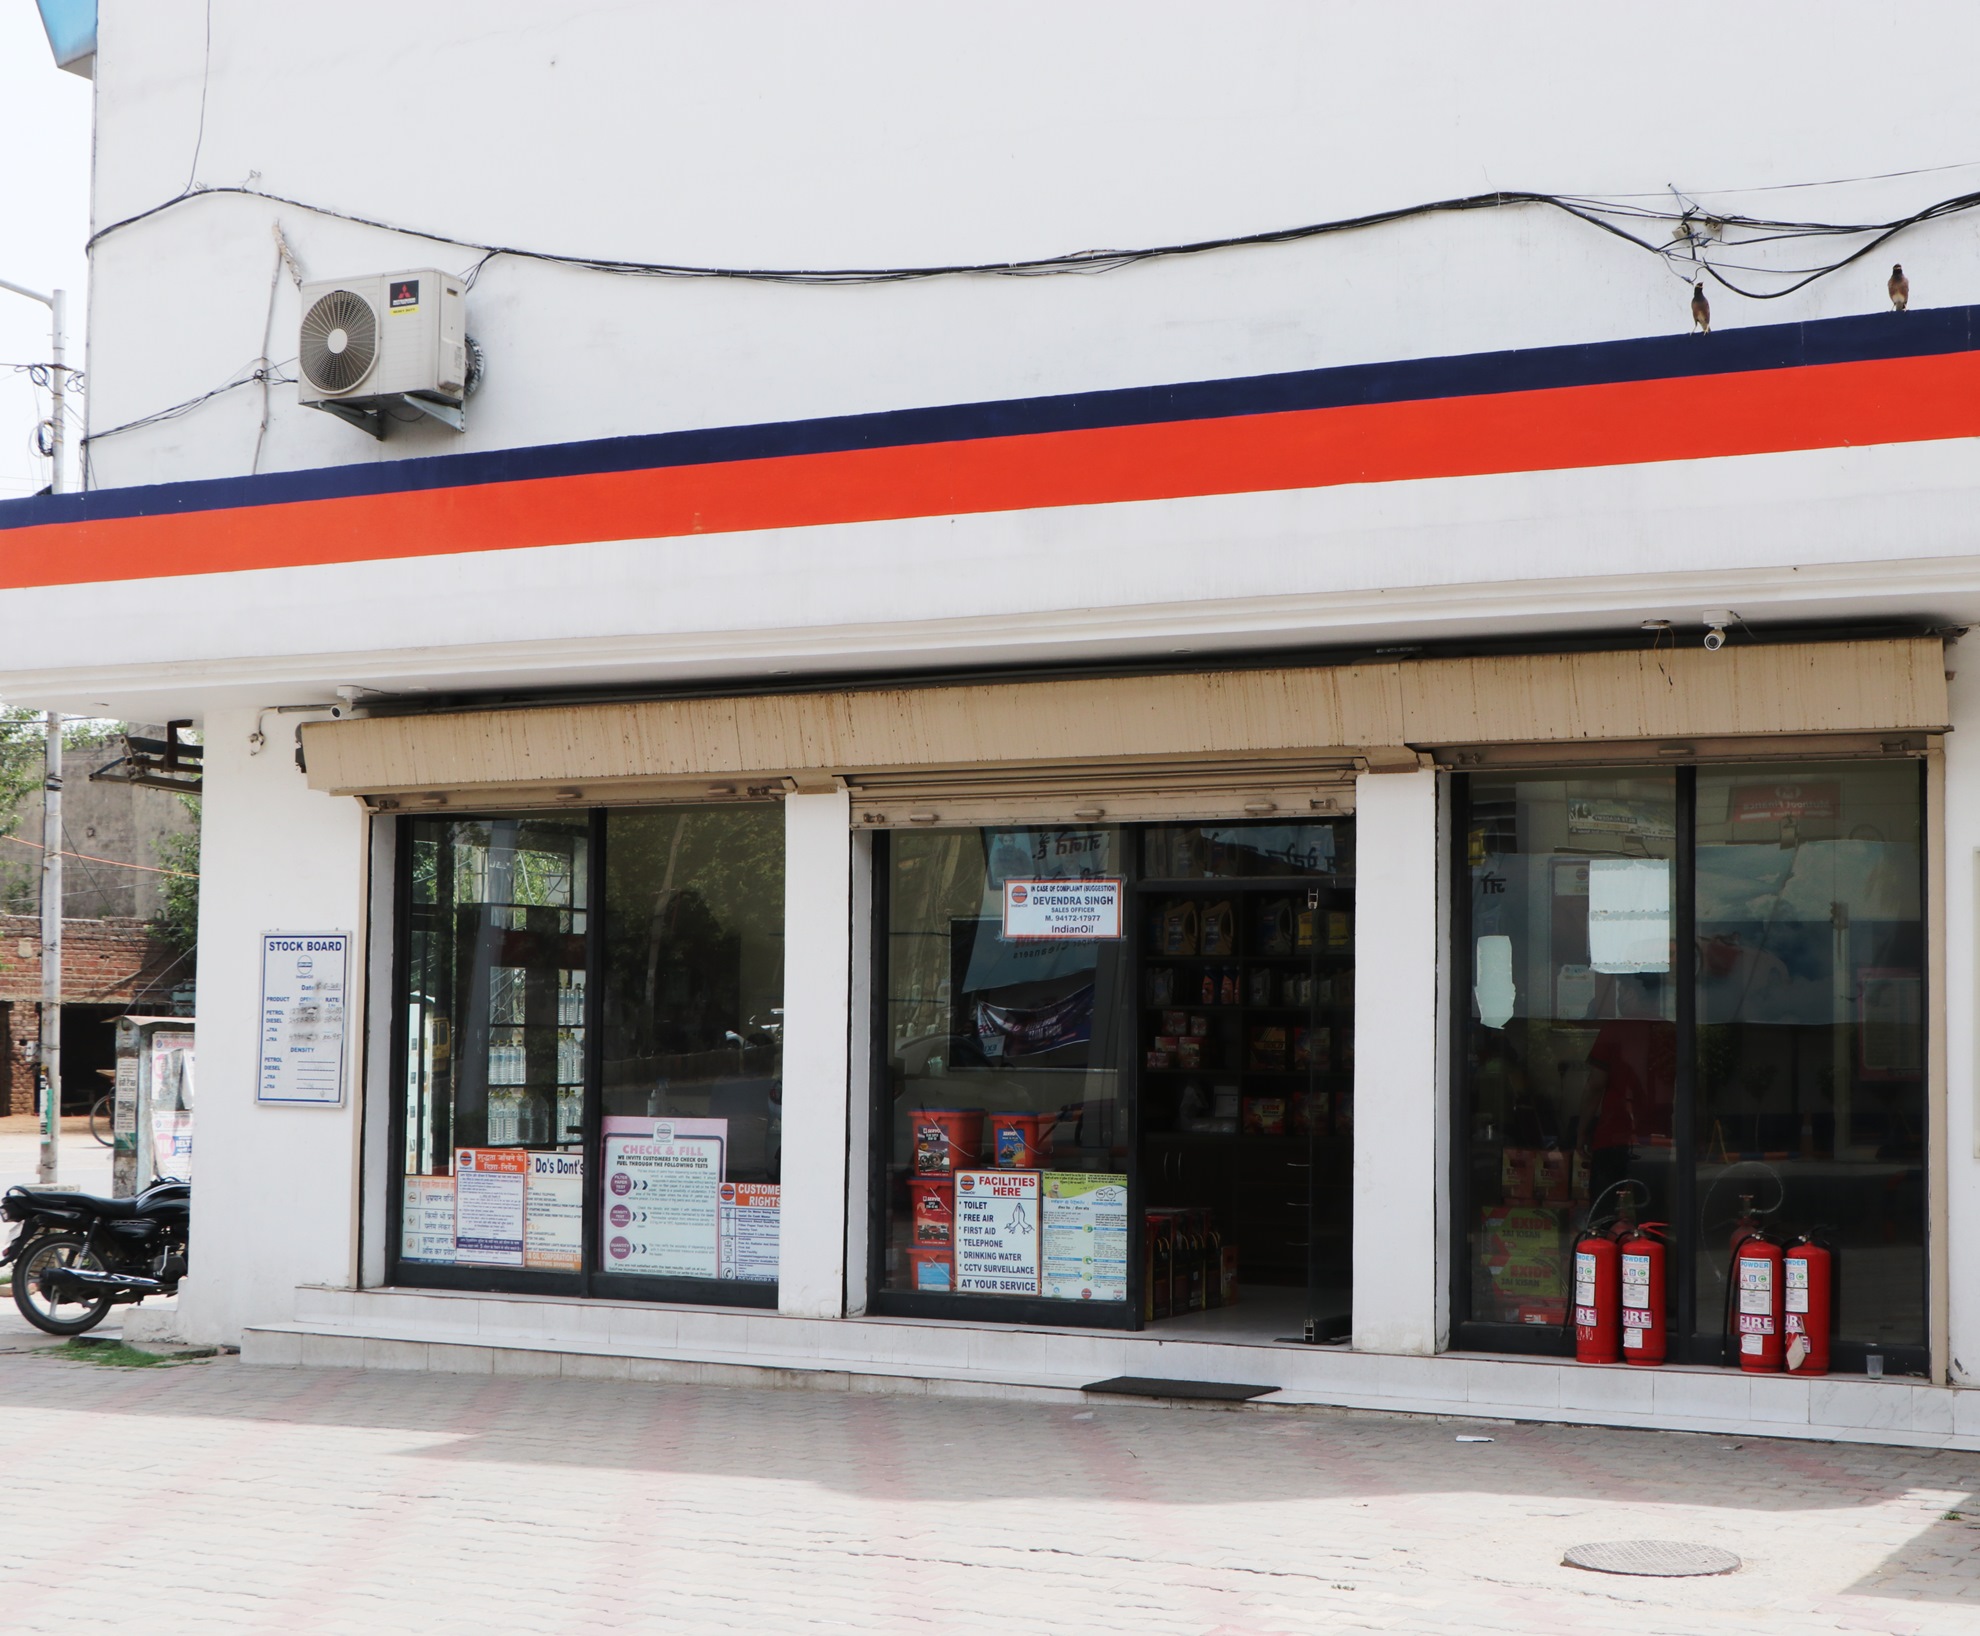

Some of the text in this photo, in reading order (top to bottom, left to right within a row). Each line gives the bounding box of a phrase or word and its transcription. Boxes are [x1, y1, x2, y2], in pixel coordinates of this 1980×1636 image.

[1033, 896, 1114, 905] DEVENDRA SINGH
[1051, 925, 1094, 933] IndianOil
[269, 941, 342, 951] STOCK BOARD
[623, 1145, 704, 1157] CHECK & FILL
[535, 1158, 583, 1175] Do's Dont's
[979, 1176, 1035, 1187] FACILITIES
[738, 1184, 780, 1195] CUSTOME
[993, 1187, 1021, 1196] HERE
[749, 1196, 780, 1207] RIGHTS
[964, 1201, 987, 1209] TOILET
[963, 1214, 994, 1222] FREE AIR
[1511, 1217, 1552, 1230] EXIDE
[963, 1226, 996, 1235] FIRST AID
[963, 1239, 1003, 1248] TELEPHONE
[963, 1251, 1022, 1261] DRINKING WATER
[964, 1263, 1035, 1275] CCTV SURVEILLANCE
[1511, 1264, 1552, 1278] EXIDE
[961, 1279, 1036, 1291] AT YOUR SERVICE
[1578, 1309, 1595, 1321] RE
[1740, 1316, 1773, 1329] FIRE
